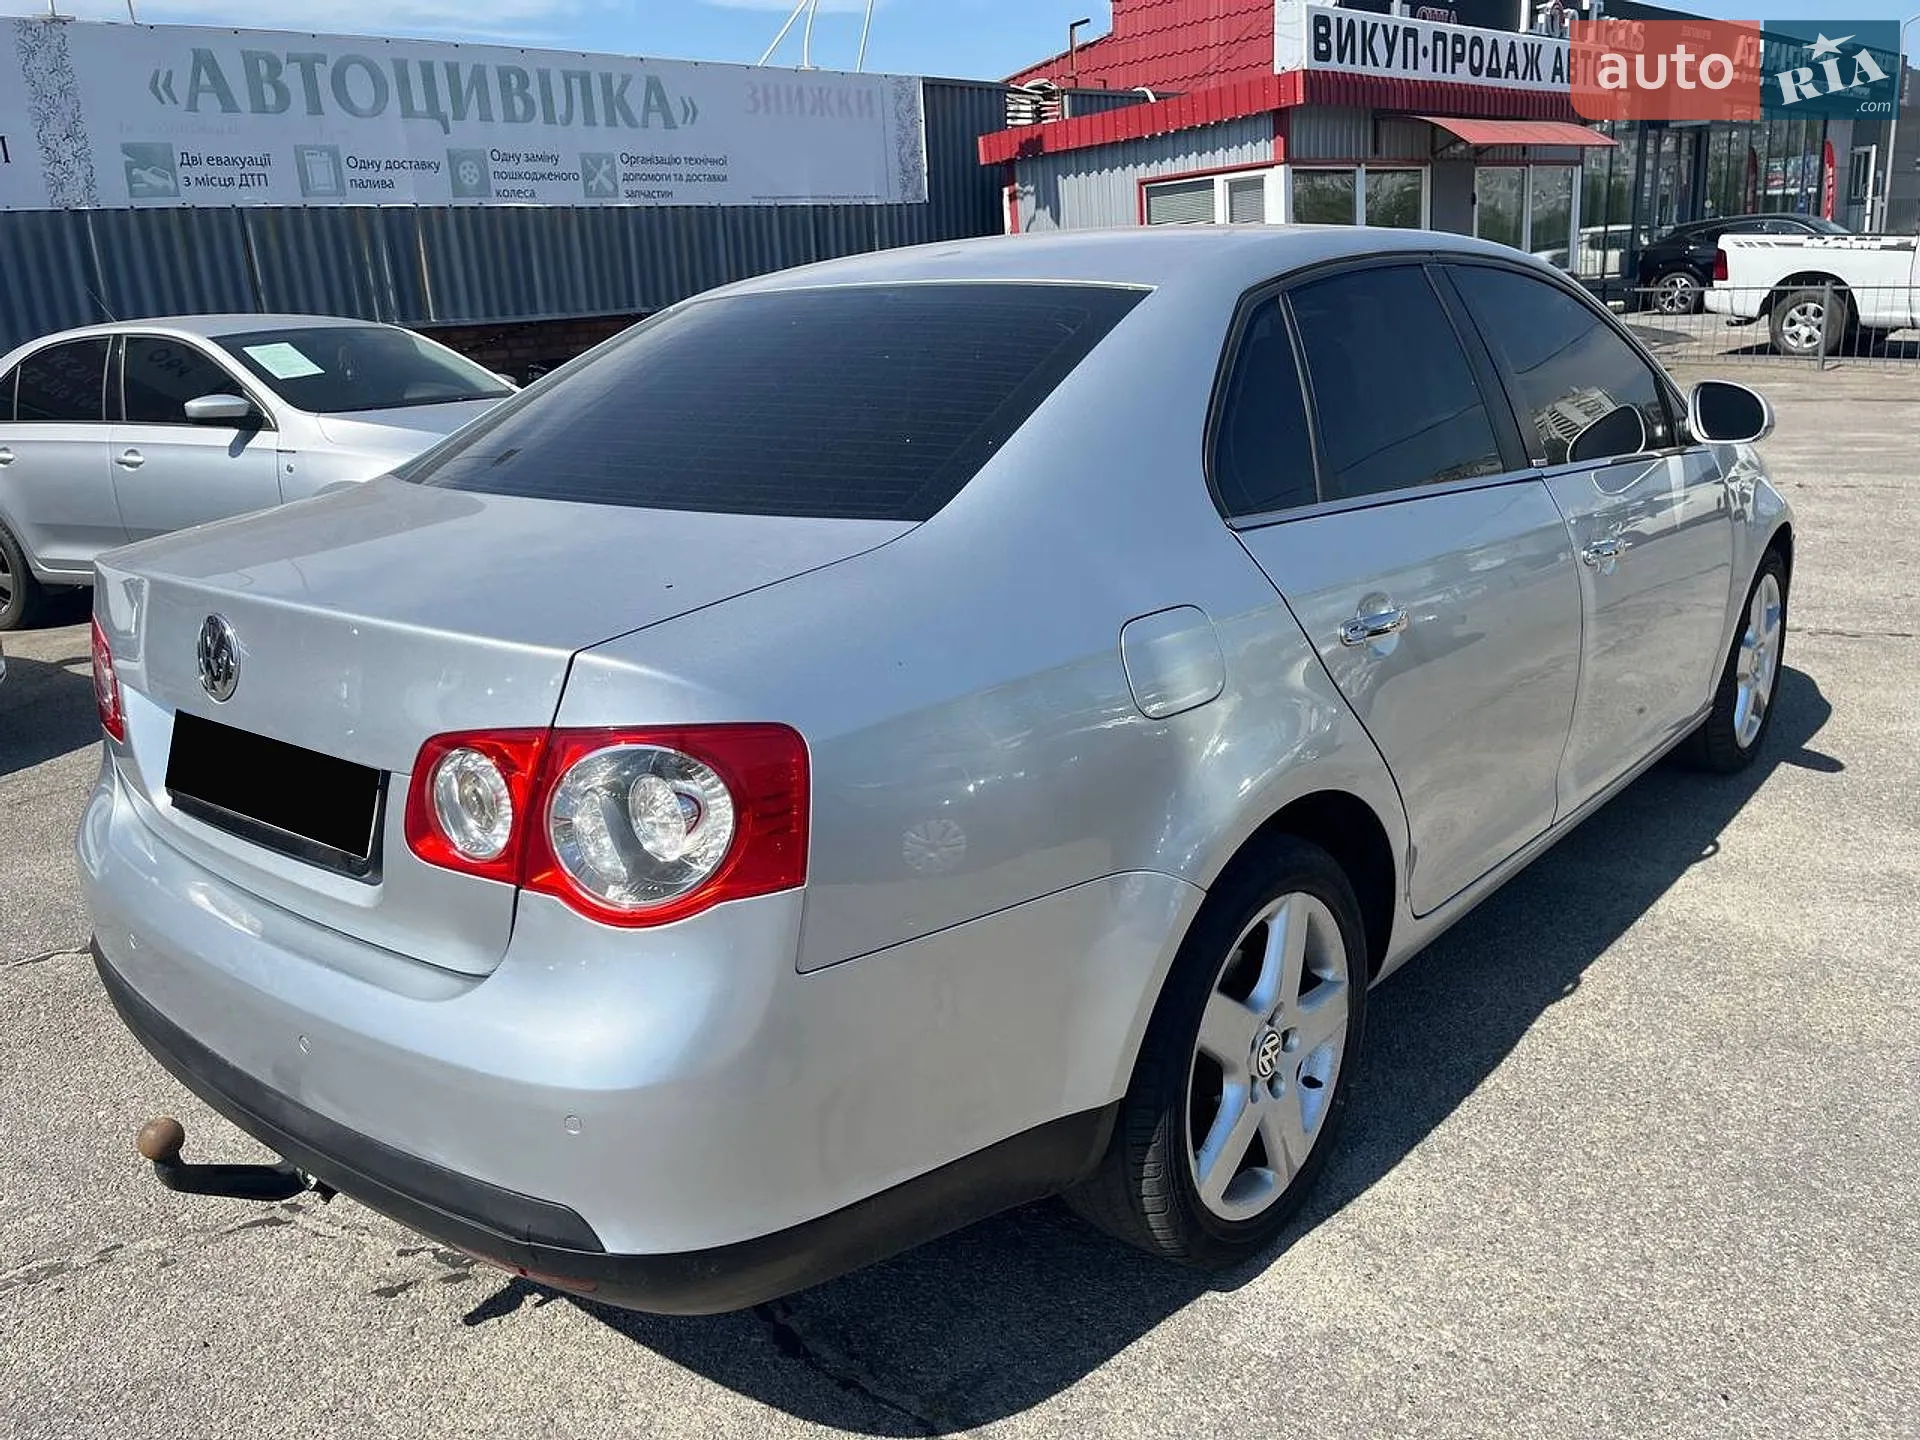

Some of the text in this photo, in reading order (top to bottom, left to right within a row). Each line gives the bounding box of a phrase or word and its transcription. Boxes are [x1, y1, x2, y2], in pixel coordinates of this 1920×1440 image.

[149, 47, 698, 134] «АВТОЦИВІЛКА»
[745, 81, 875, 118] ЗНИЖКИ
[180, 152, 271, 170] Дві евакуації
[490, 149, 560, 165] Одну заміну
[620, 153, 728, 167] Організацію технічної
[346, 156, 441, 173] Одну доставку
[183, 173, 268, 188] з місця ДТП
[493, 170, 580, 182] пошкодженого
[622, 172, 728, 183] допомоги та доставки
[350, 178, 395, 189] палива
[495, 188, 537, 198] колеса
[624, 189, 673, 199] запчастин
